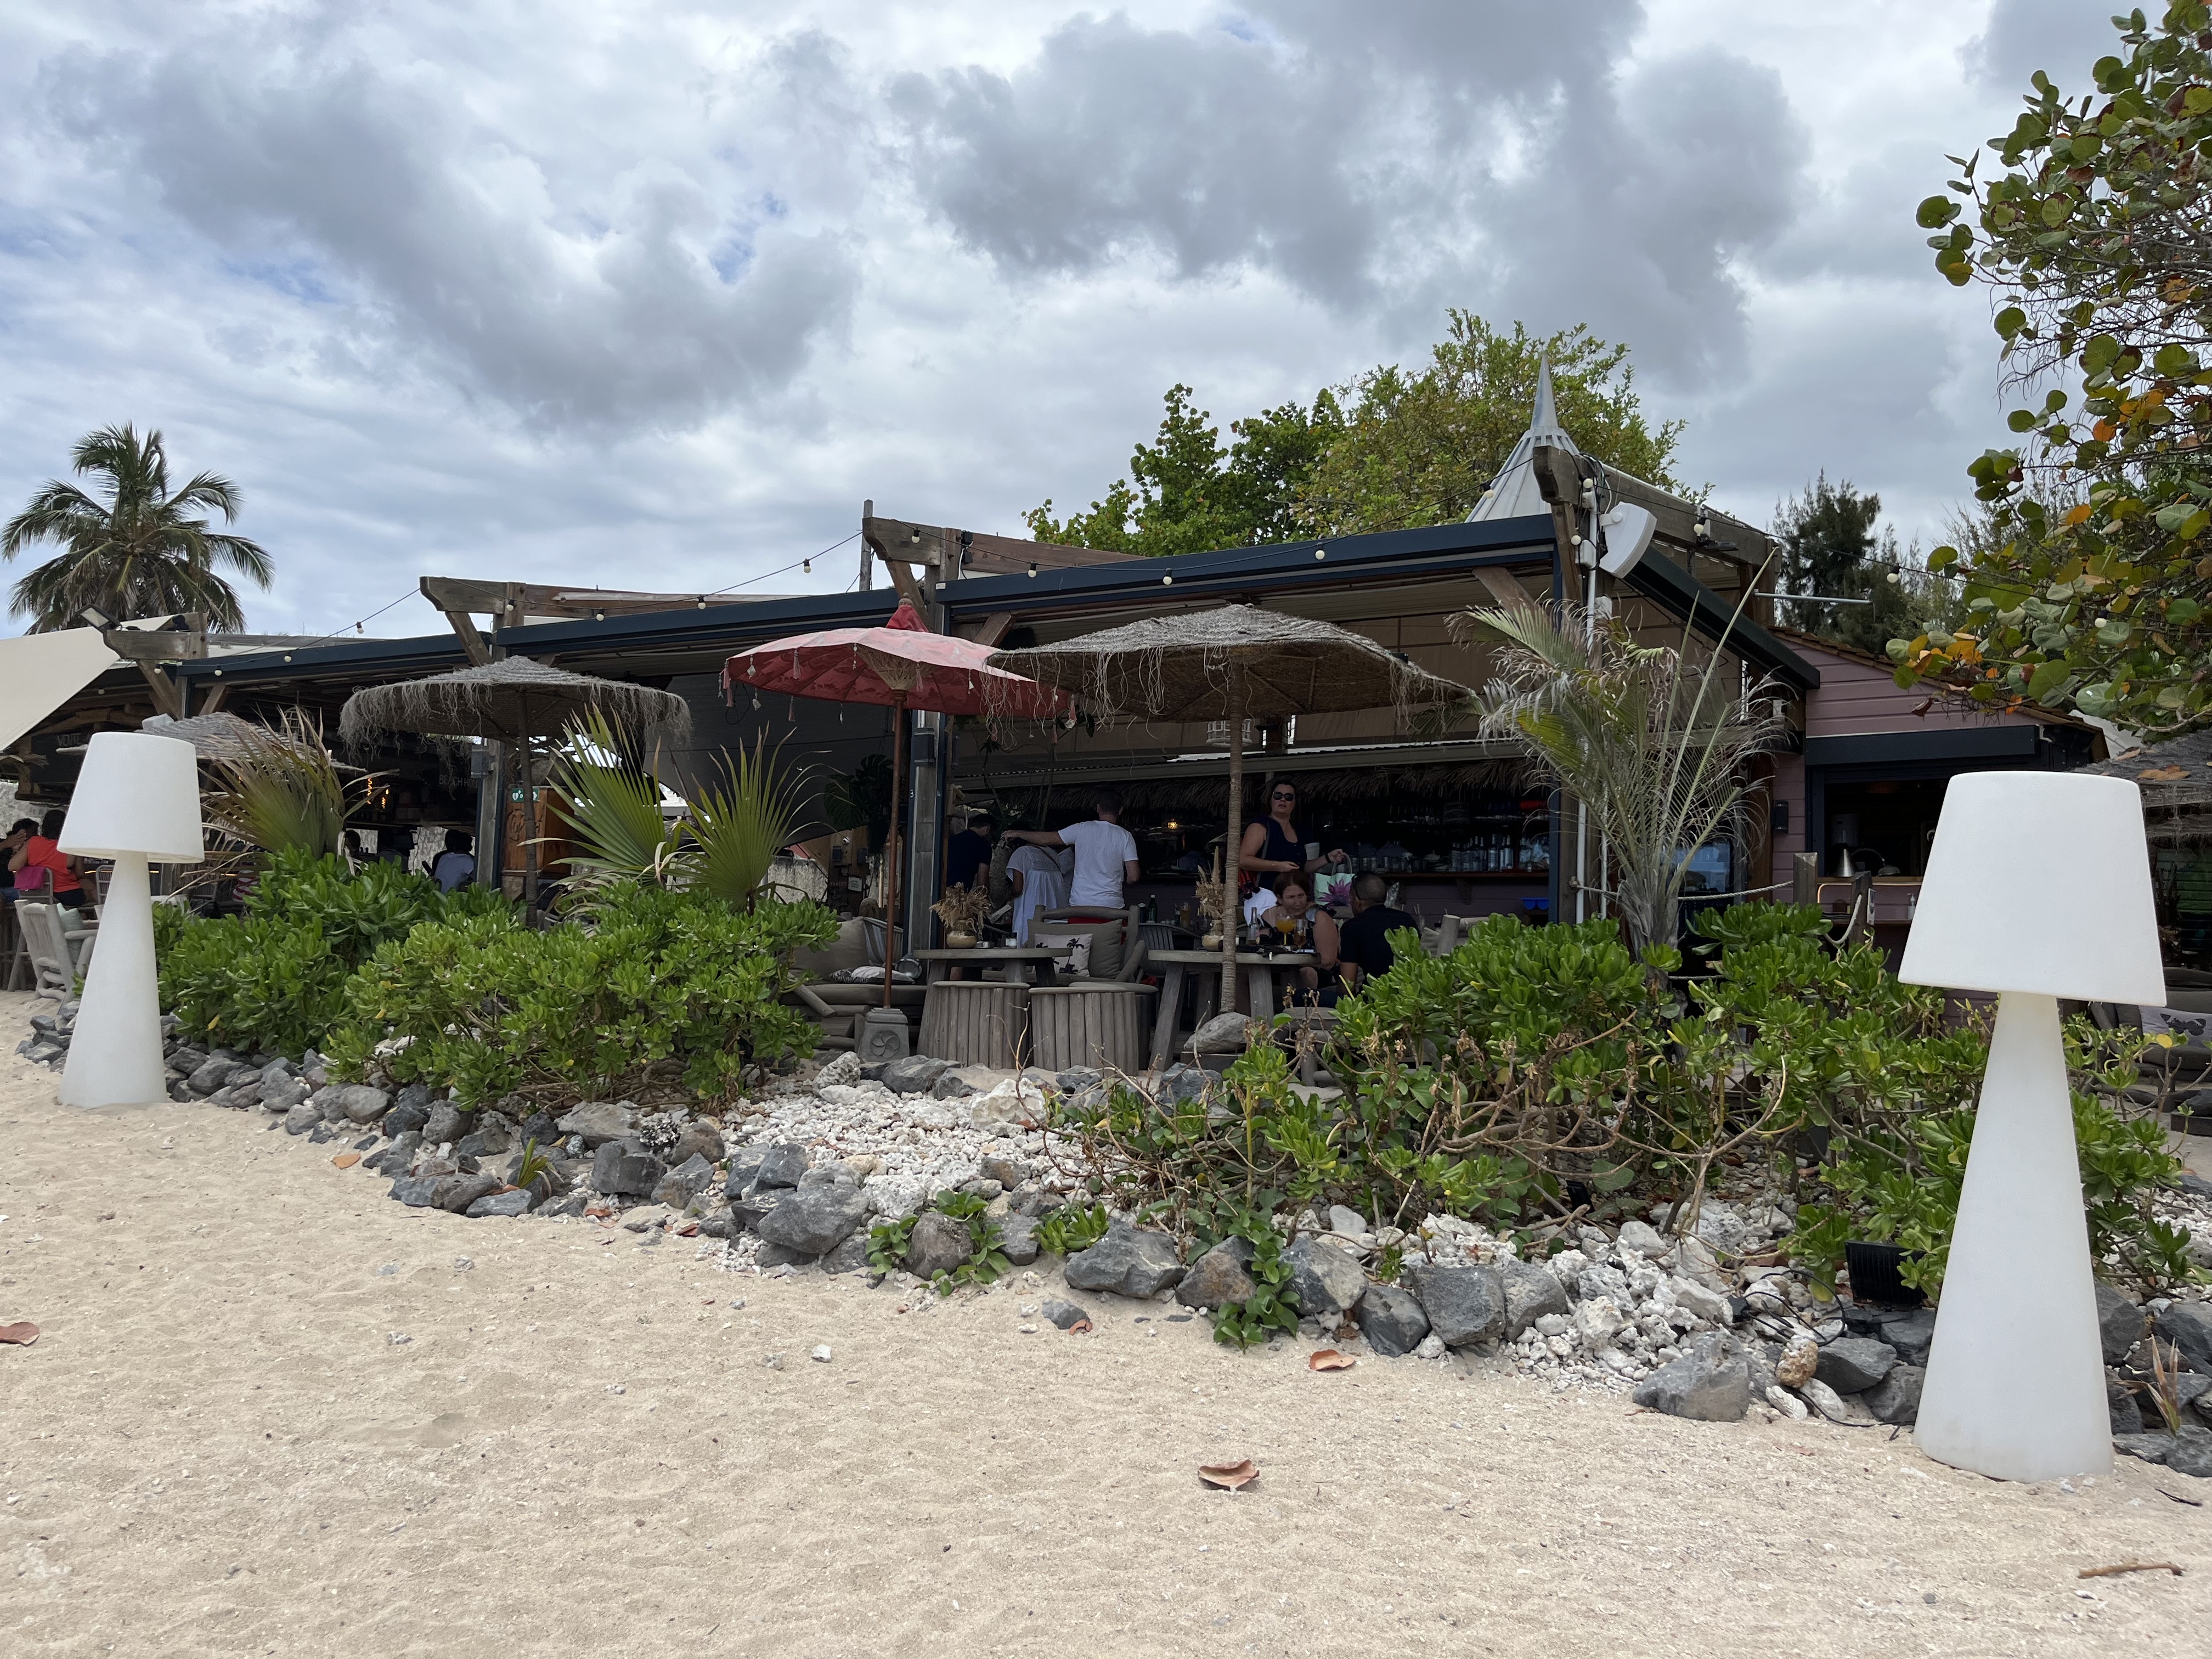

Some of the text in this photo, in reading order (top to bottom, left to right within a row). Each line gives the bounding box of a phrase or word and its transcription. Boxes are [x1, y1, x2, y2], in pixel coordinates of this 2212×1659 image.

[439, 775, 478, 788] BEACH HOU
[910, 789, 914, 798] 3
